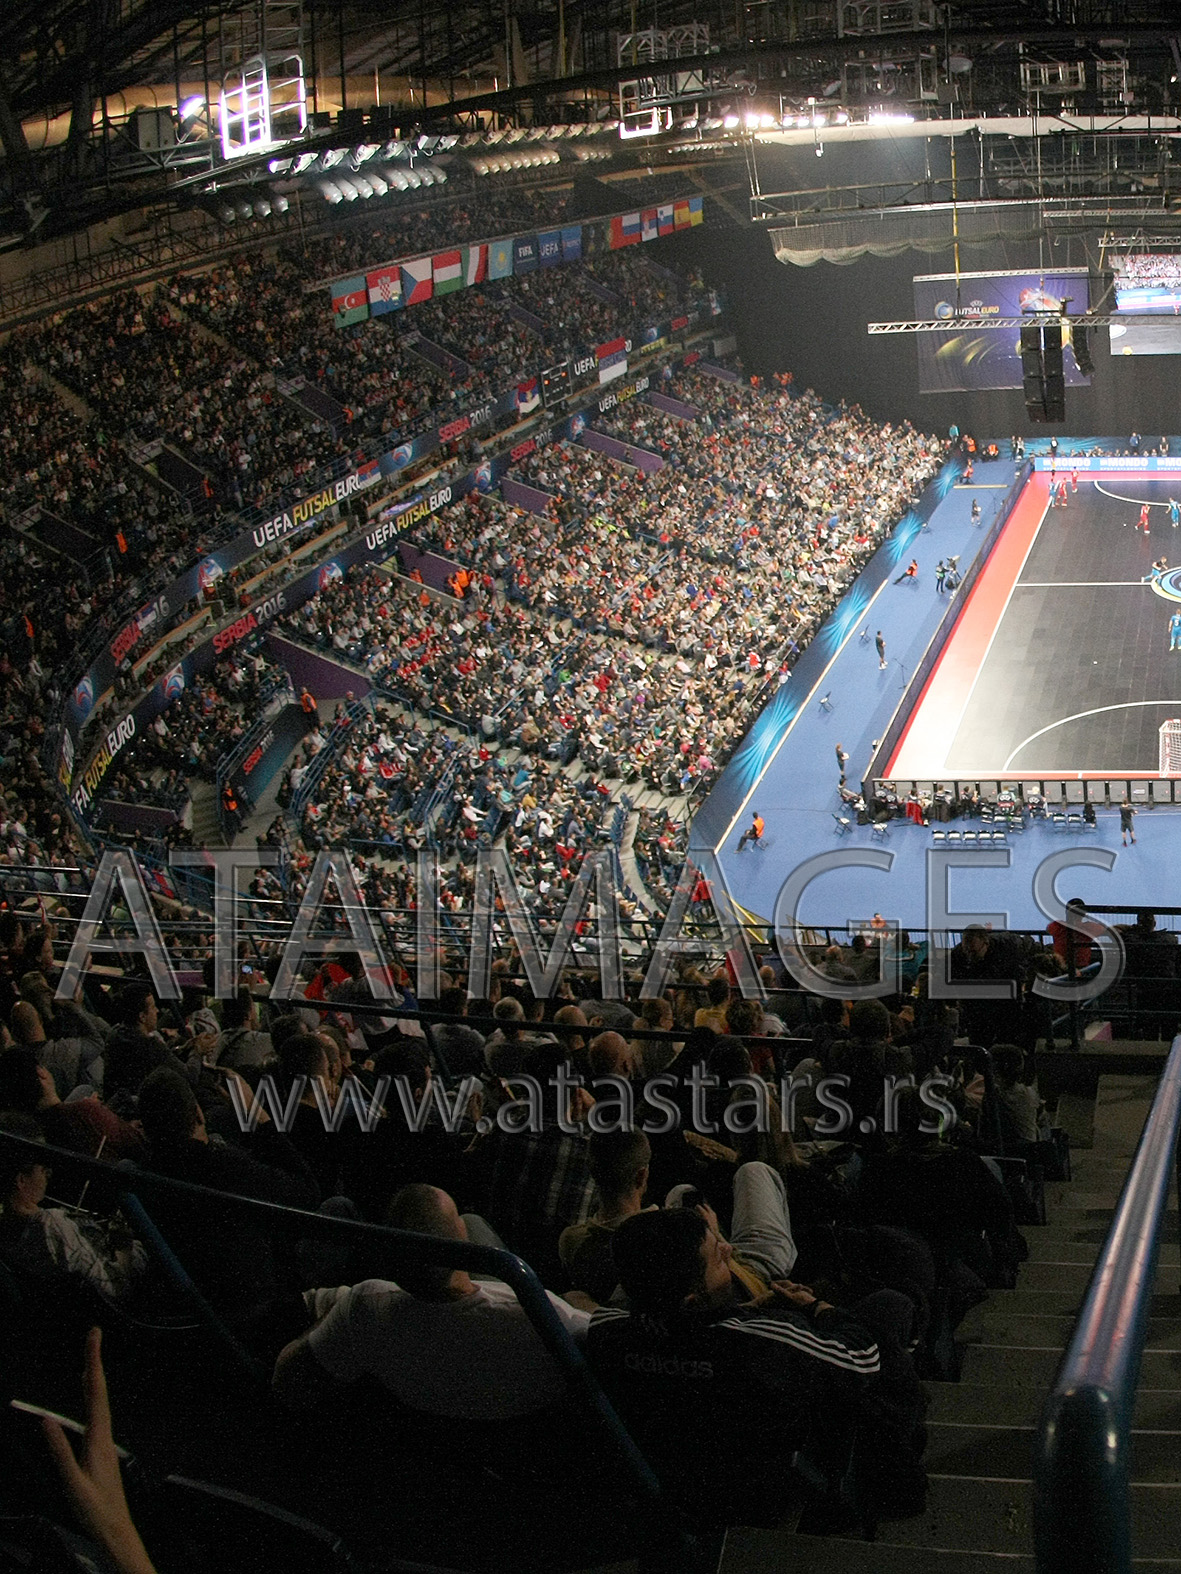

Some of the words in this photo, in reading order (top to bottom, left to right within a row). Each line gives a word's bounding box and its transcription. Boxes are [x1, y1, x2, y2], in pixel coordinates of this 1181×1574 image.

[518, 245, 533, 257] FIFA
[540, 243, 559, 256] UEFA
[574, 354, 597, 375] UEFA
[599, 393, 617, 412] UEFA
[438, 416, 471, 443] SERBIA
[469, 405, 491, 428] 2016
[252, 513, 293, 548] UEFA
[366, 522, 398, 550] UEFA
[212, 613, 258, 654] SERBIA
[255, 592, 287, 625] 2016
